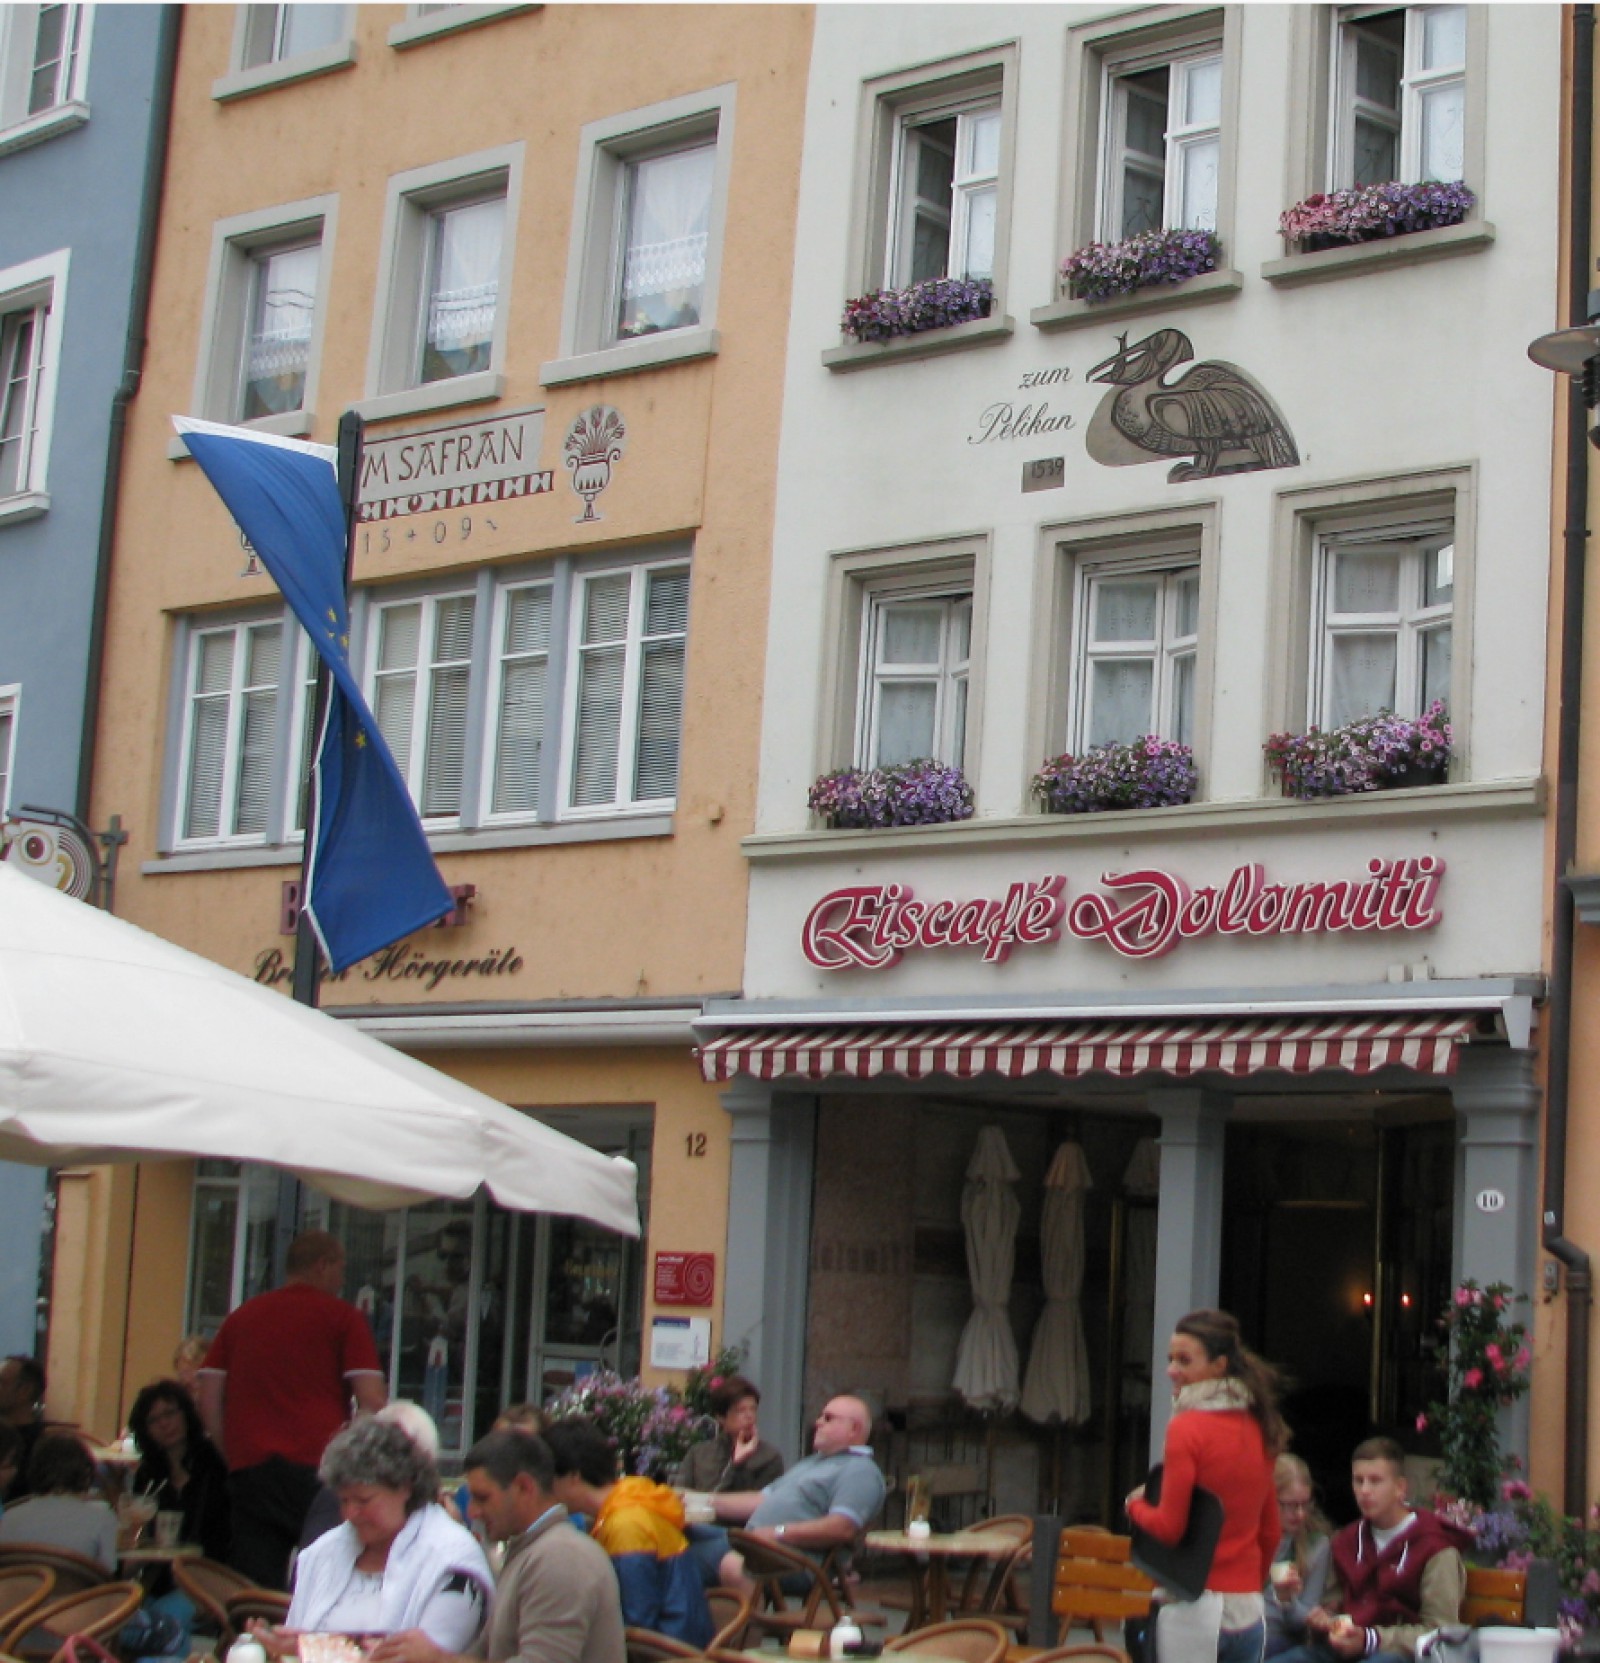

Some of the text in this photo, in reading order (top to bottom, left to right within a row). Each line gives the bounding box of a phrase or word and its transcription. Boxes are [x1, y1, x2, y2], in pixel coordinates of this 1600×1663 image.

[1018, 366, 1073, 390] zum
[967, 402, 1076, 445] Pelikan
[398, 425, 524, 480] SAFRAN
[801, 855, 1446, 969] Eiscafé Dolomiti
[686, 1132, 707, 1157] 12
[1482, 1193, 1499, 1208] 10
